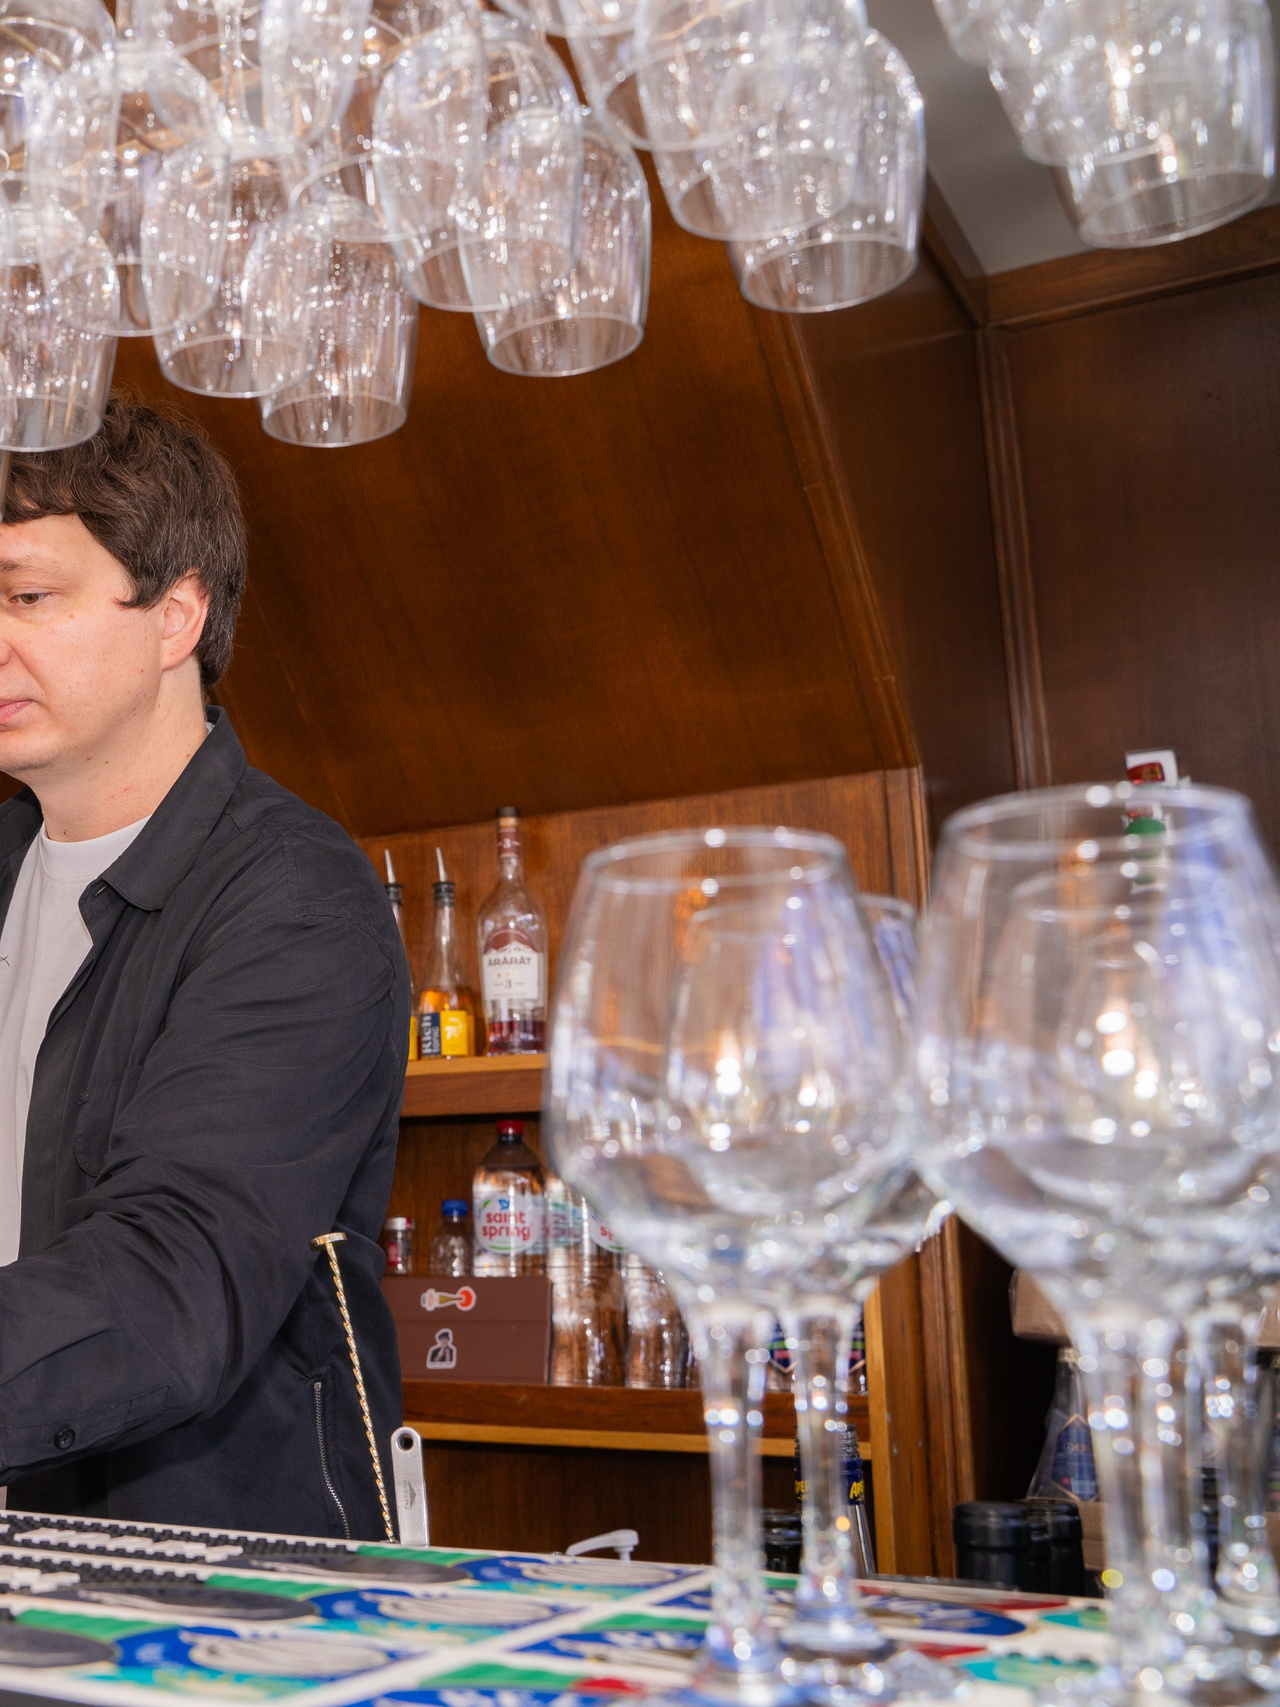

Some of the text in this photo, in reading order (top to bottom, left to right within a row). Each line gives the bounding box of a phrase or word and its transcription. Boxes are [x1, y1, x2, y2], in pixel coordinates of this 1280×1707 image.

[487, 956, 531, 967] ARARAT
[505, 979, 512, 989] 3
[421, 1015, 431, 1054] Rich
[486, 1211, 525, 1224] saint
[482, 1225, 530, 1242] spring
